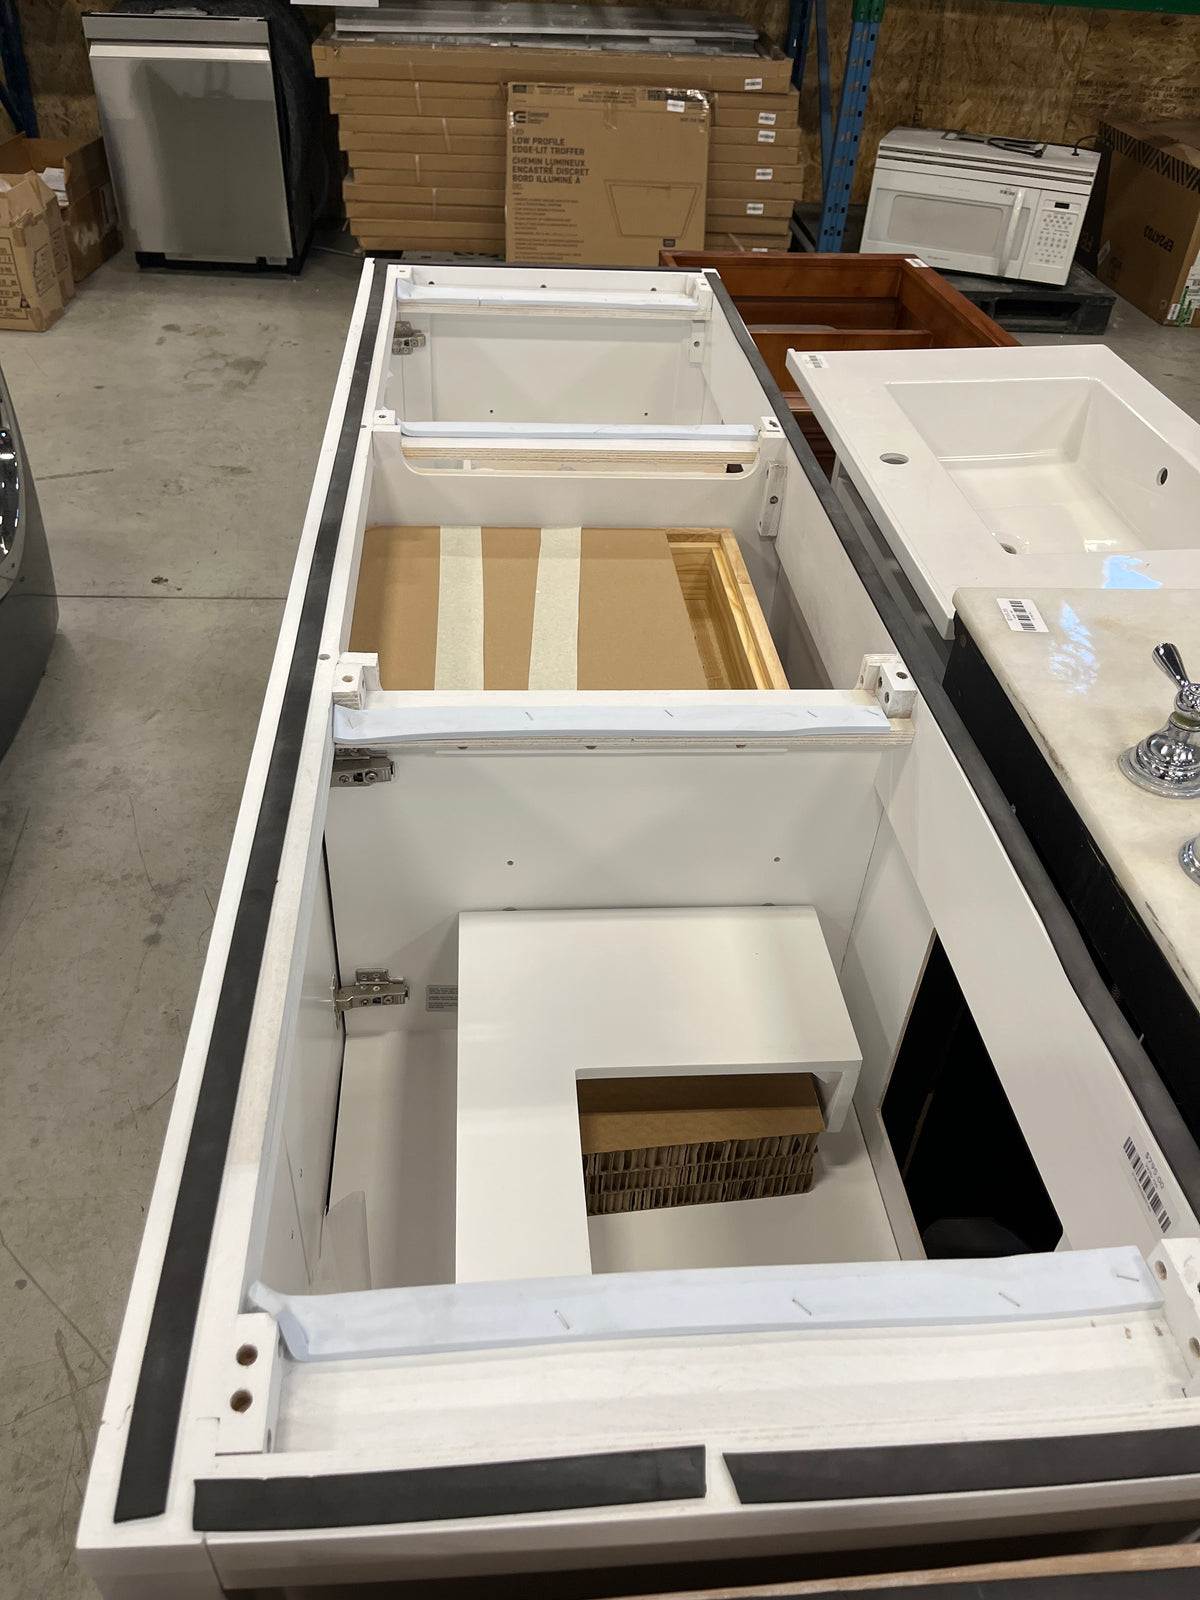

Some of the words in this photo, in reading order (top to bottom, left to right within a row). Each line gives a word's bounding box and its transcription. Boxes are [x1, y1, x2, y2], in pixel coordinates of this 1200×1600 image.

[533, 138, 565, 146] PROFILE
[512, 146, 547, 154] EDGE-LIT
[551, 147, 584, 155] TROFFER
[512, 157, 542, 165] CHEMIN
[545, 158, 585, 167] LUMINEUX
[556, 167, 589, 176] DISCRET
[512, 174, 534, 182] BORD
